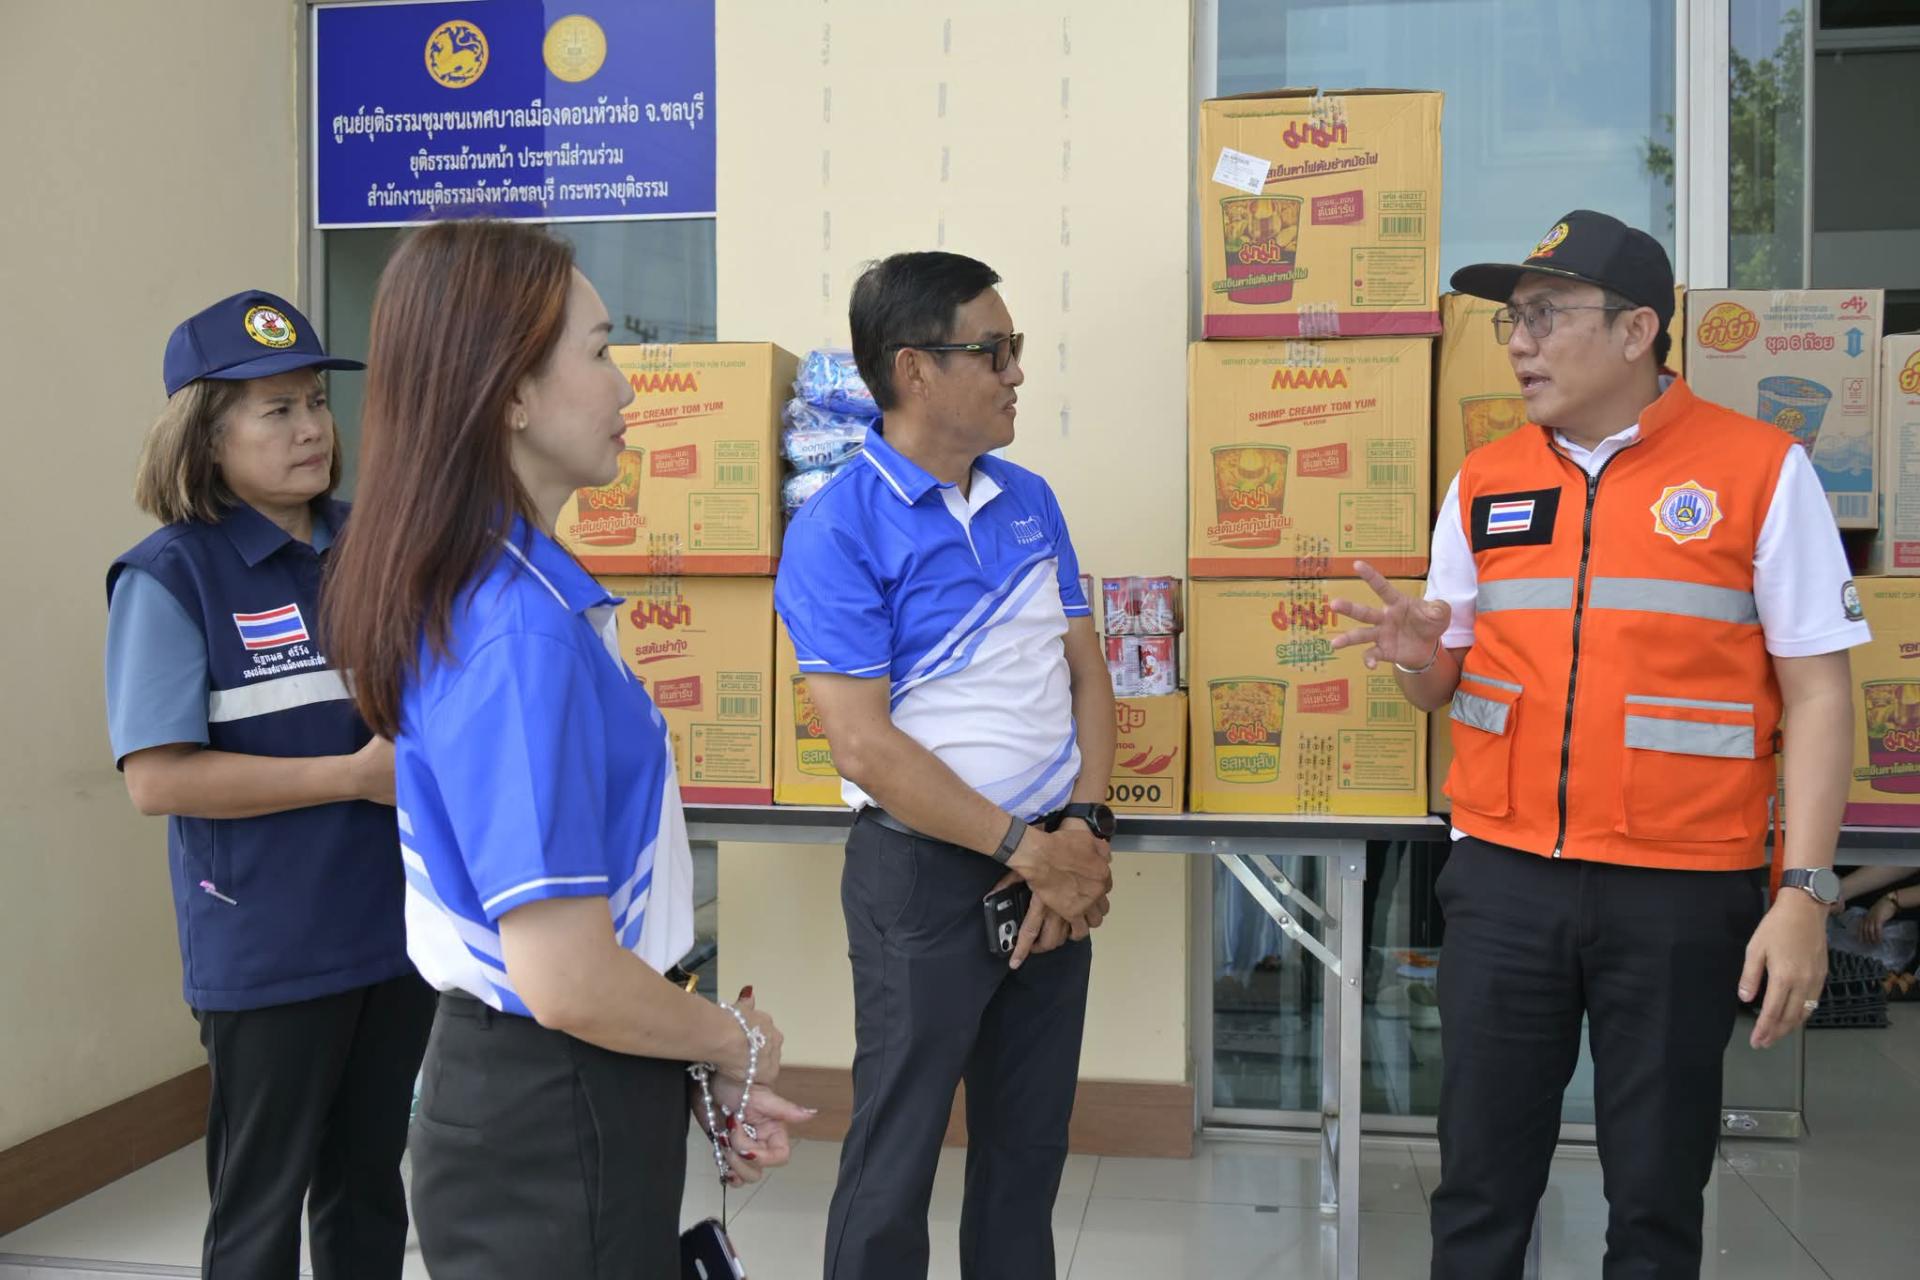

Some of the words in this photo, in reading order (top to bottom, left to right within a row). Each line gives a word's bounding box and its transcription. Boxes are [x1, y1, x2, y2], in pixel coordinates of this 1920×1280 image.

[645, 92, 705, 130] จ.ชลบุรี
[409, 145, 514, 178] ยุติธรรมถ้วนหน้า
[518, 142, 624, 170] ประชามีส่วนร่วม
[1267, 152, 1379, 178] สเย็นตาโฟต้มยำหม้อไฟ
[366, 178, 555, 211] สำนักงานยุติธรรมจังหวัดชลบุรี
[559, 175, 669, 206] กระทรวงยุติธรรม
[1789, 335, 1802, 350] 6
[630, 372, 698, 393] MAMA
[1271, 368, 1348, 390] MAMA
[624, 411, 641, 421] IMP
[643, 407, 679, 419] CREAMY
[681, 404, 701, 415] TOM
[703, 400, 724, 412] YUM
[1249, 410, 1286, 422] SHRIMP
[1289, 404, 1328, 417] CREAMY
[1331, 400, 1352, 411] TOM
[1354, 398, 1377, 409] YUM
[631, 594, 691, 630] มาม่า
[1270, 594, 1339, 631] มาม่า
[635, 639, 688, 656] รสต้มยำกุ้ง
